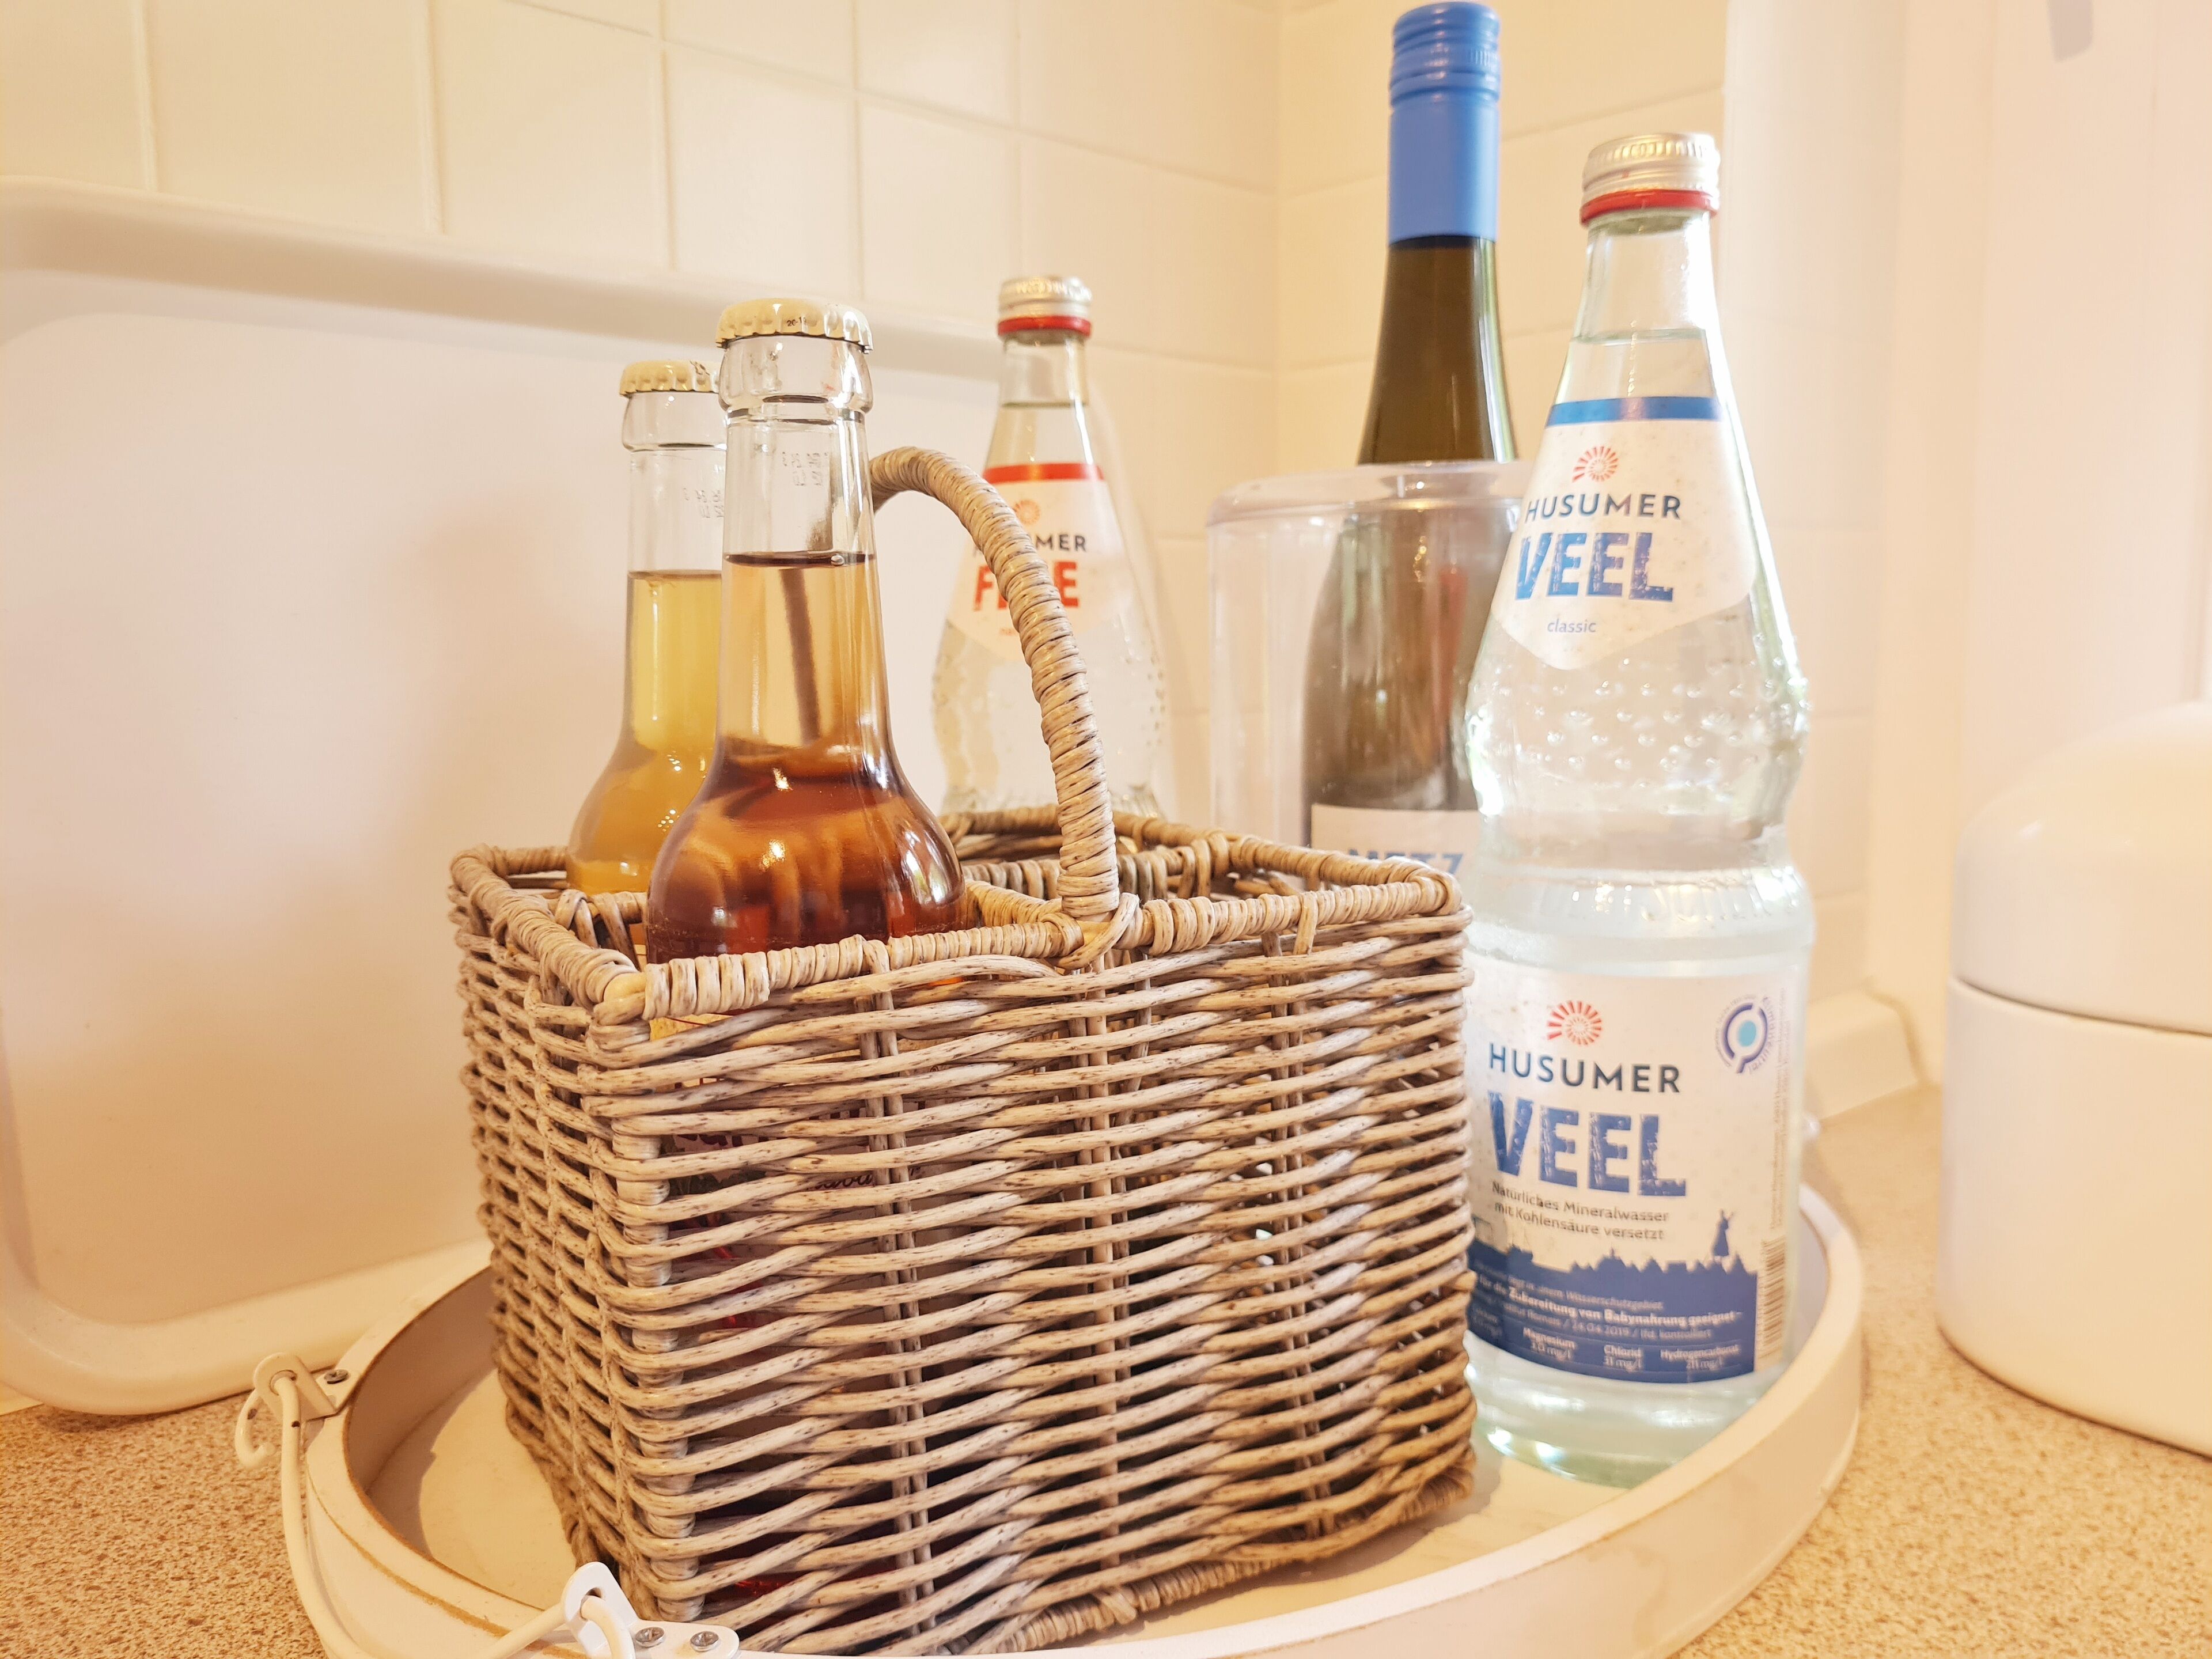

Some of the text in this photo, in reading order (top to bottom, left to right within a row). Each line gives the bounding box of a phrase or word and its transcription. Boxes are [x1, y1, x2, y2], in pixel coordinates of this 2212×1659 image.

[1524, 494, 1681, 523] HUSUMER
[974, 560, 1080, 612] FE
[1514, 532, 1674, 603] VEEL
[1547, 619, 1597, 634] classic
[1488, 1042, 1681, 1093] HUSUMER
[1487, 1090, 1687, 1196] VEEL
[1495, 1202, 1664, 1240] mit Kohlensäure versetzt
[1563, 1201, 1669, 1222] Mineralwasser
[1509, 1286, 1578, 1319] Zubereitung
[1579, 1308, 1603, 1320] von
[1604, 1308, 1687, 1330] Babynahrung
[1604, 1344, 1642, 1360] Chlorid
